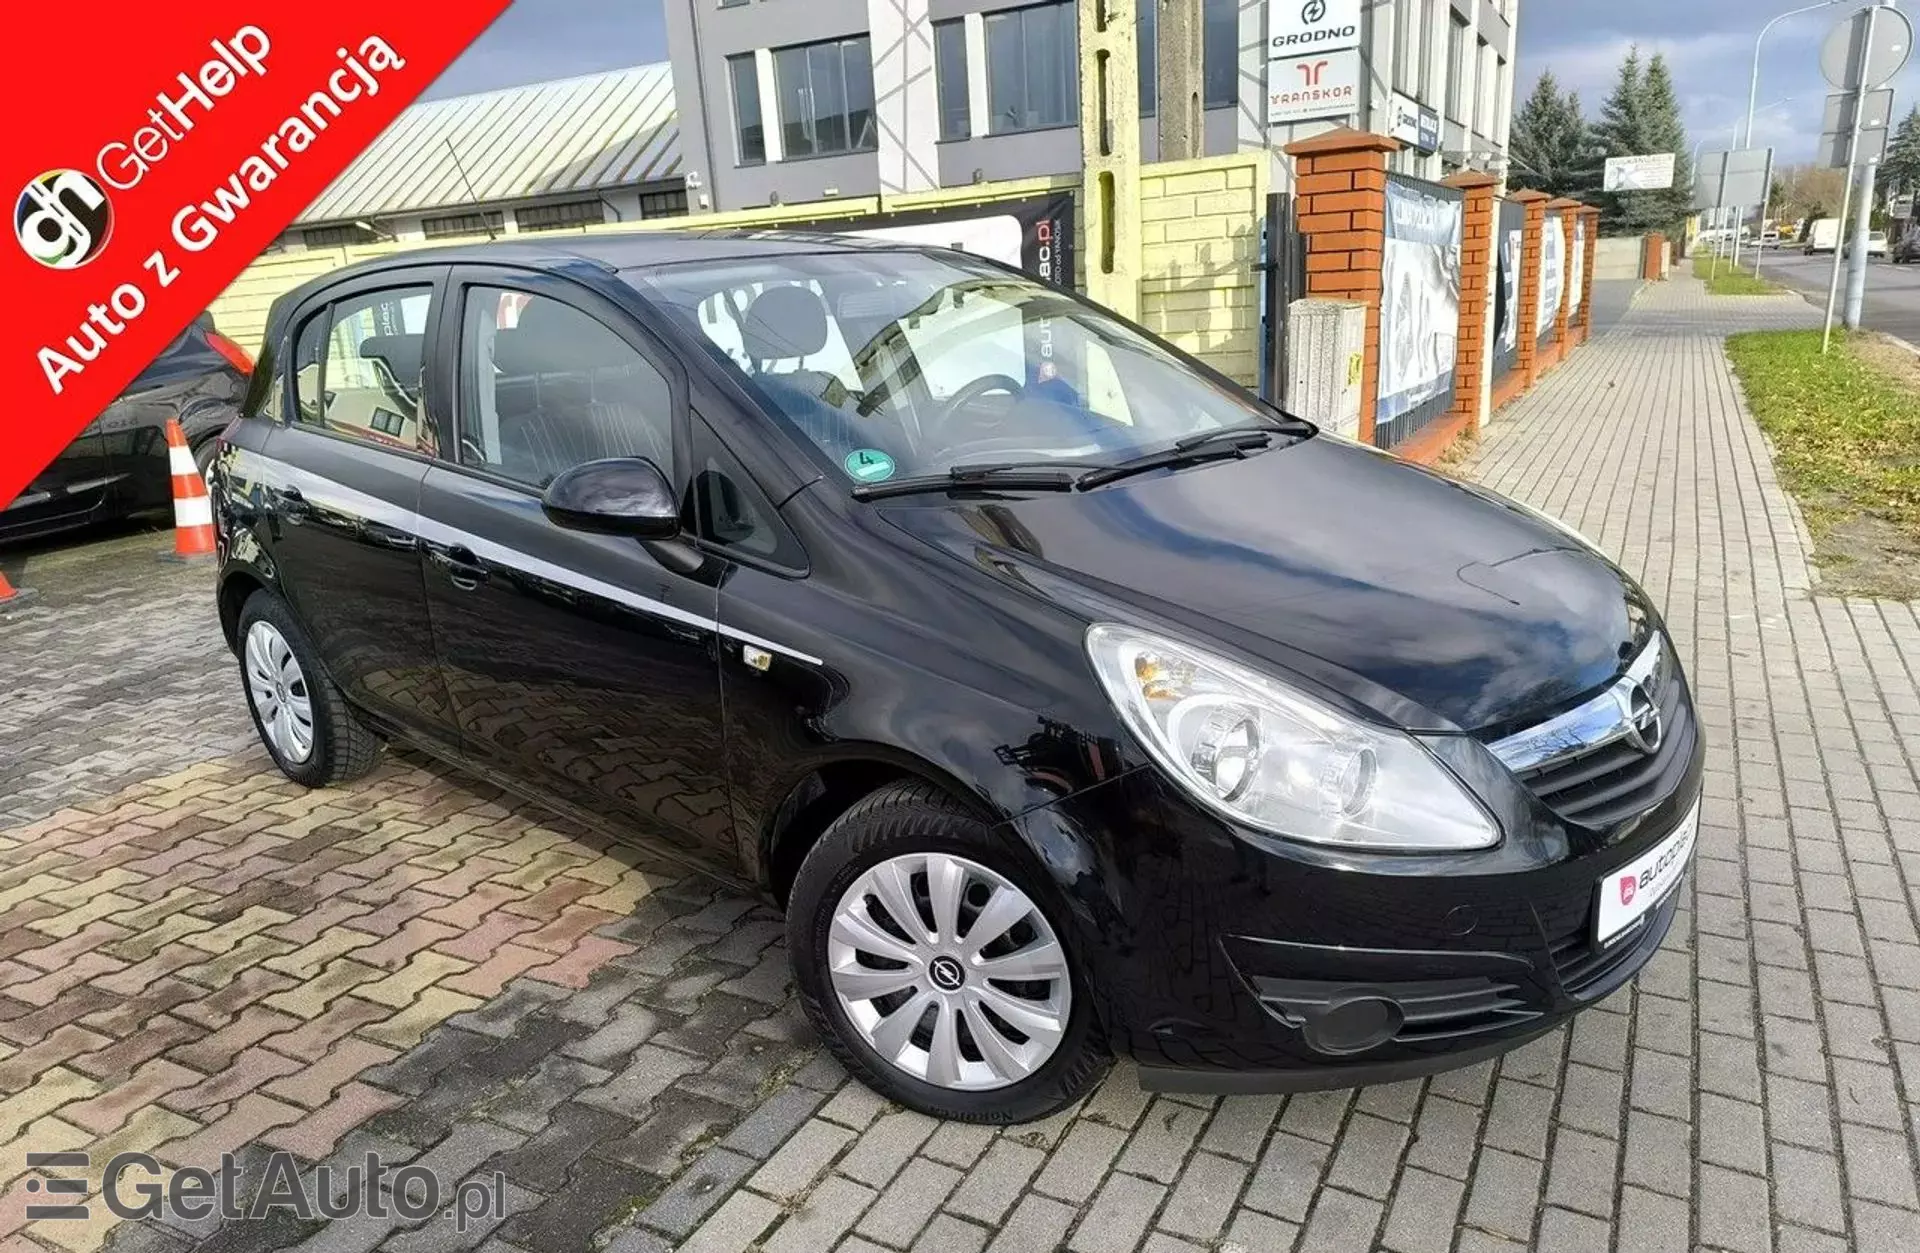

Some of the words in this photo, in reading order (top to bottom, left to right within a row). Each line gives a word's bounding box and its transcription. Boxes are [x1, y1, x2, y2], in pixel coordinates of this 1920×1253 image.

[1272, 25, 1356, 48] GRODNO
[1270, 85, 1353, 105] TRANSKOR
[859, 452, 874, 465] 4
